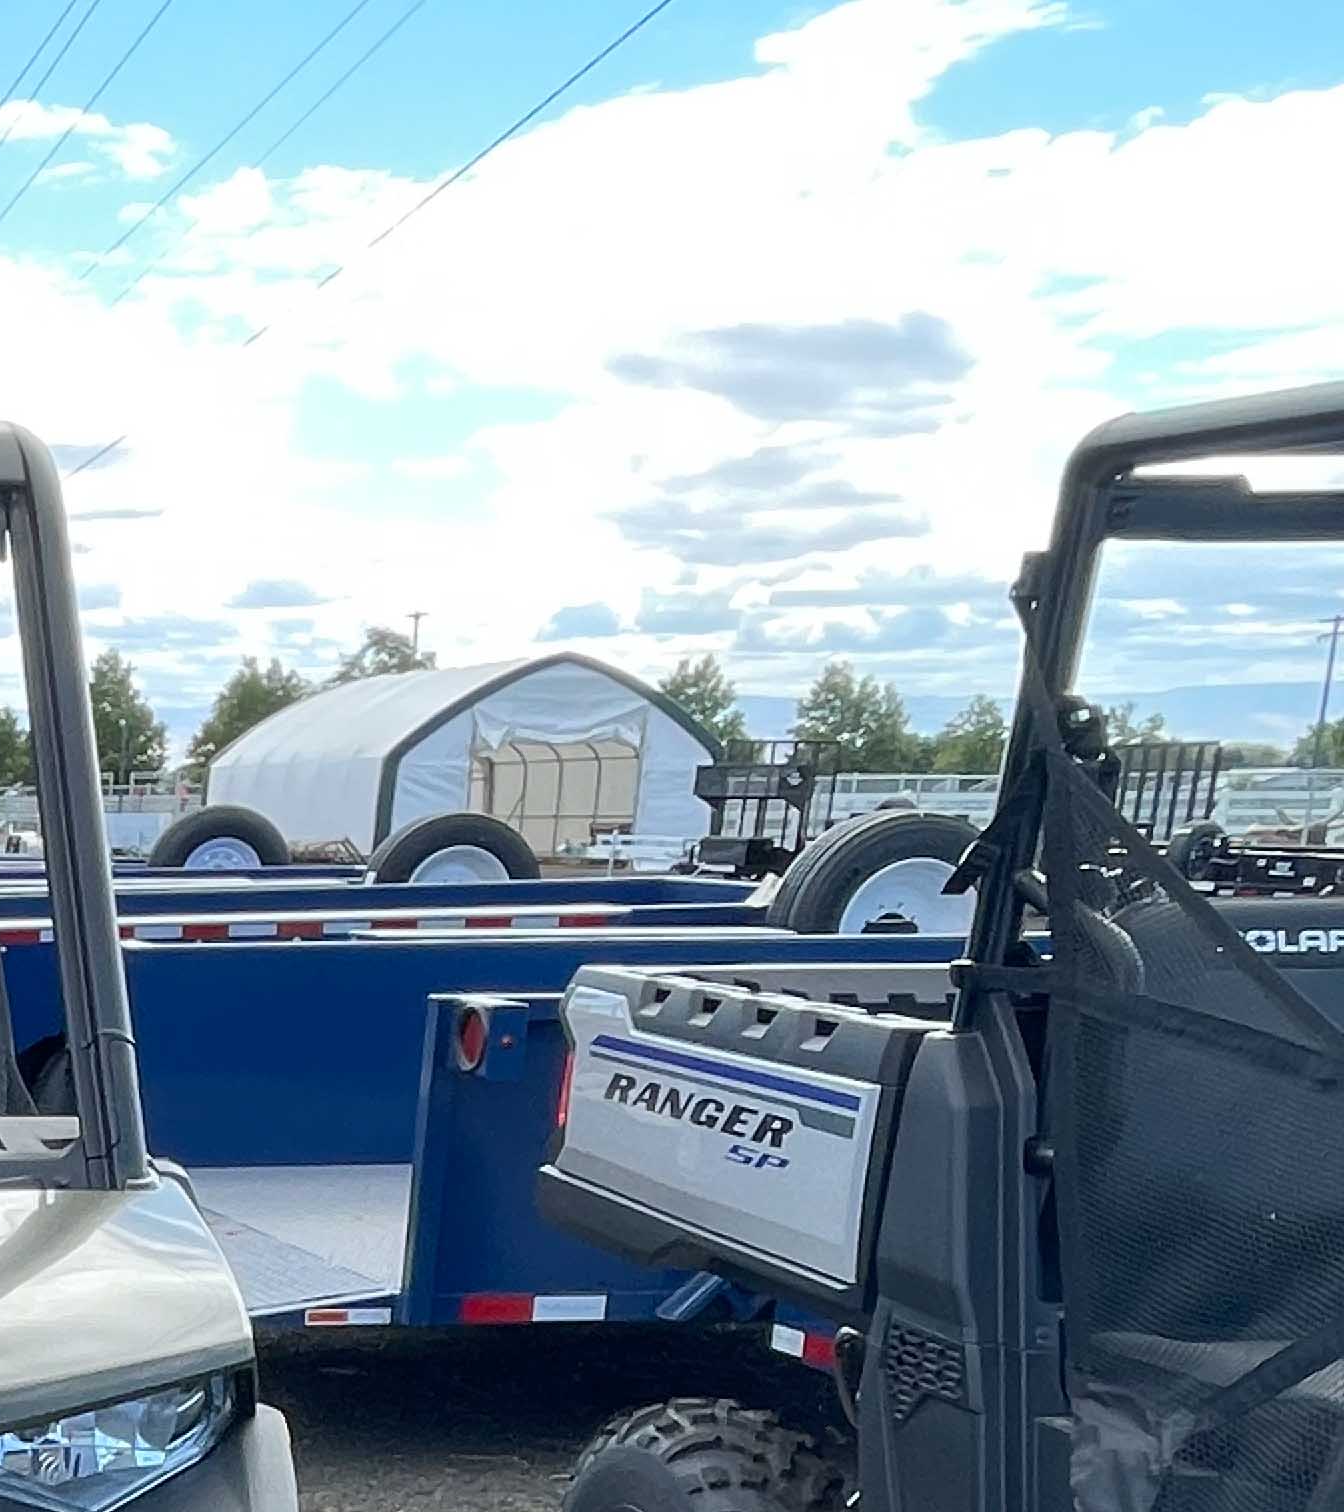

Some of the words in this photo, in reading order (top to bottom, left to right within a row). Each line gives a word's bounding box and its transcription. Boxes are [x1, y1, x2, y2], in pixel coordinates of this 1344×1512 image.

[1234, 929, 1344, 953] OLA
[604, 1072, 794, 1148] RANGER
[724, 1144, 790, 1168] SP
